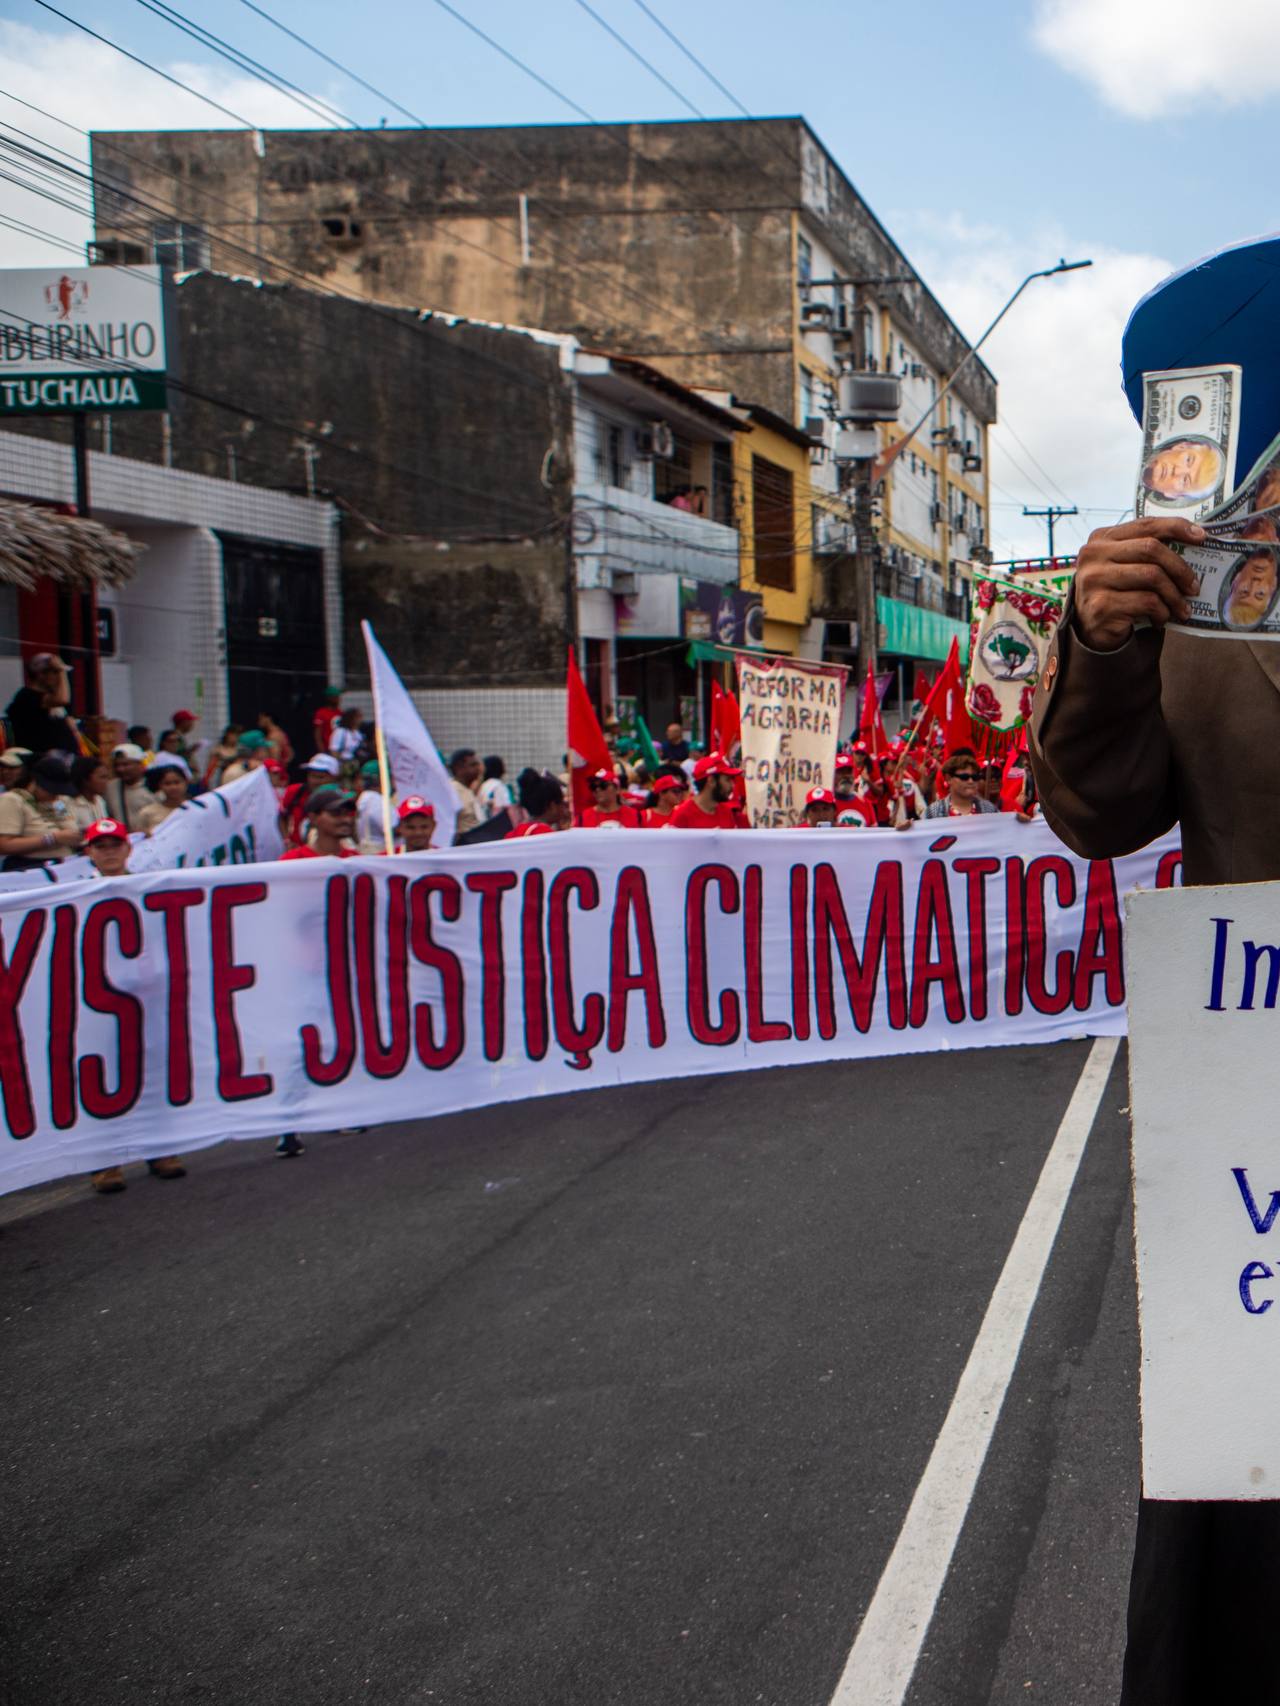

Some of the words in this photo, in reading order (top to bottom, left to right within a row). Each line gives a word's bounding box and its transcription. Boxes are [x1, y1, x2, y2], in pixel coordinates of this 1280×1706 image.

[1, 377, 140, 407] TUCHAUA
[742, 671, 836, 707] REFORMA
[780, 734, 792, 756] E
[742, 756, 823, 785] COMIDA
[766, 783, 793, 808] NA
[300, 866, 667, 1086] JUSTIÇA
[685, 835, 1126, 1046] CLIMÁTICA
